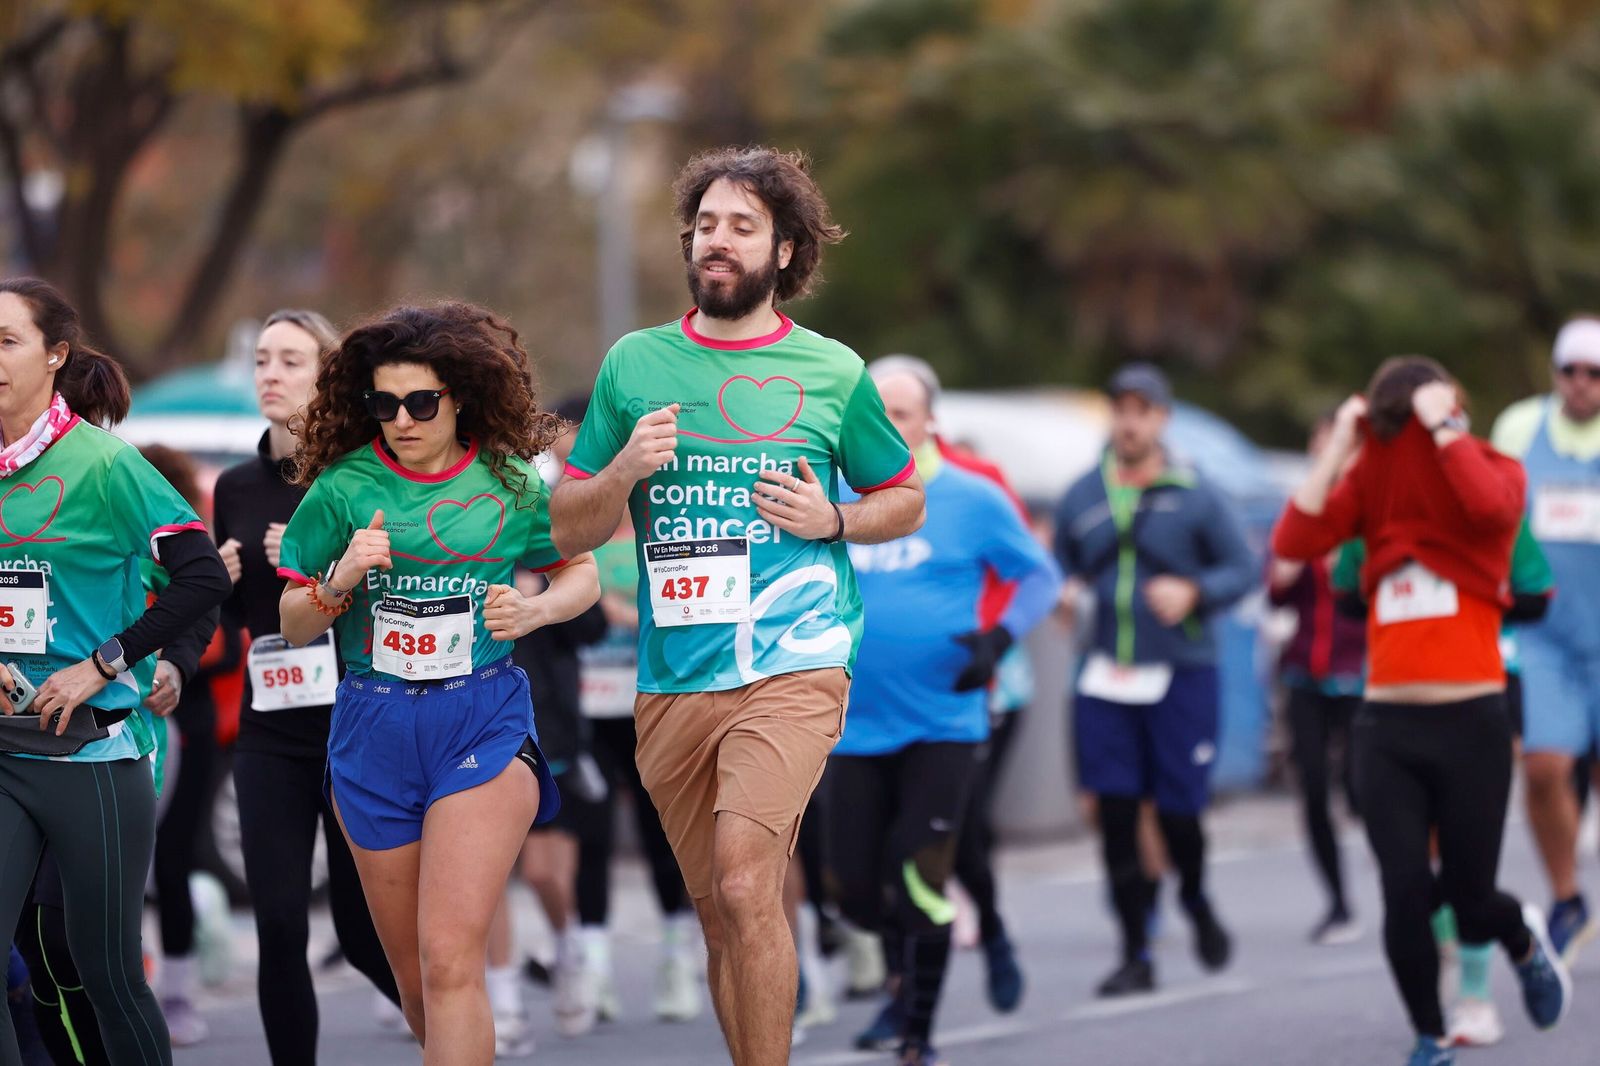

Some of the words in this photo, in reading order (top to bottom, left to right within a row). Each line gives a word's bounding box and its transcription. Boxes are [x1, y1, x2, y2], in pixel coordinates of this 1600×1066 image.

[656, 454, 679, 472] n
[687, 452, 793, 476] marcha
[649, 480, 751, 508] contra
[669, 544, 692, 553] Marcha
[695, 543, 719, 554] 2026
[366, 569, 391, 590] En
[396, 573, 488, 596] marcha
[661, 575, 710, 601] 437
[385, 599, 395, 607] En
[396, 600, 419, 612] Marcha
[422, 603, 446, 614] 2026
[383, 630, 437, 656] 438
[263, 666, 304, 688] 598
[443, 679, 466, 691] adidas
